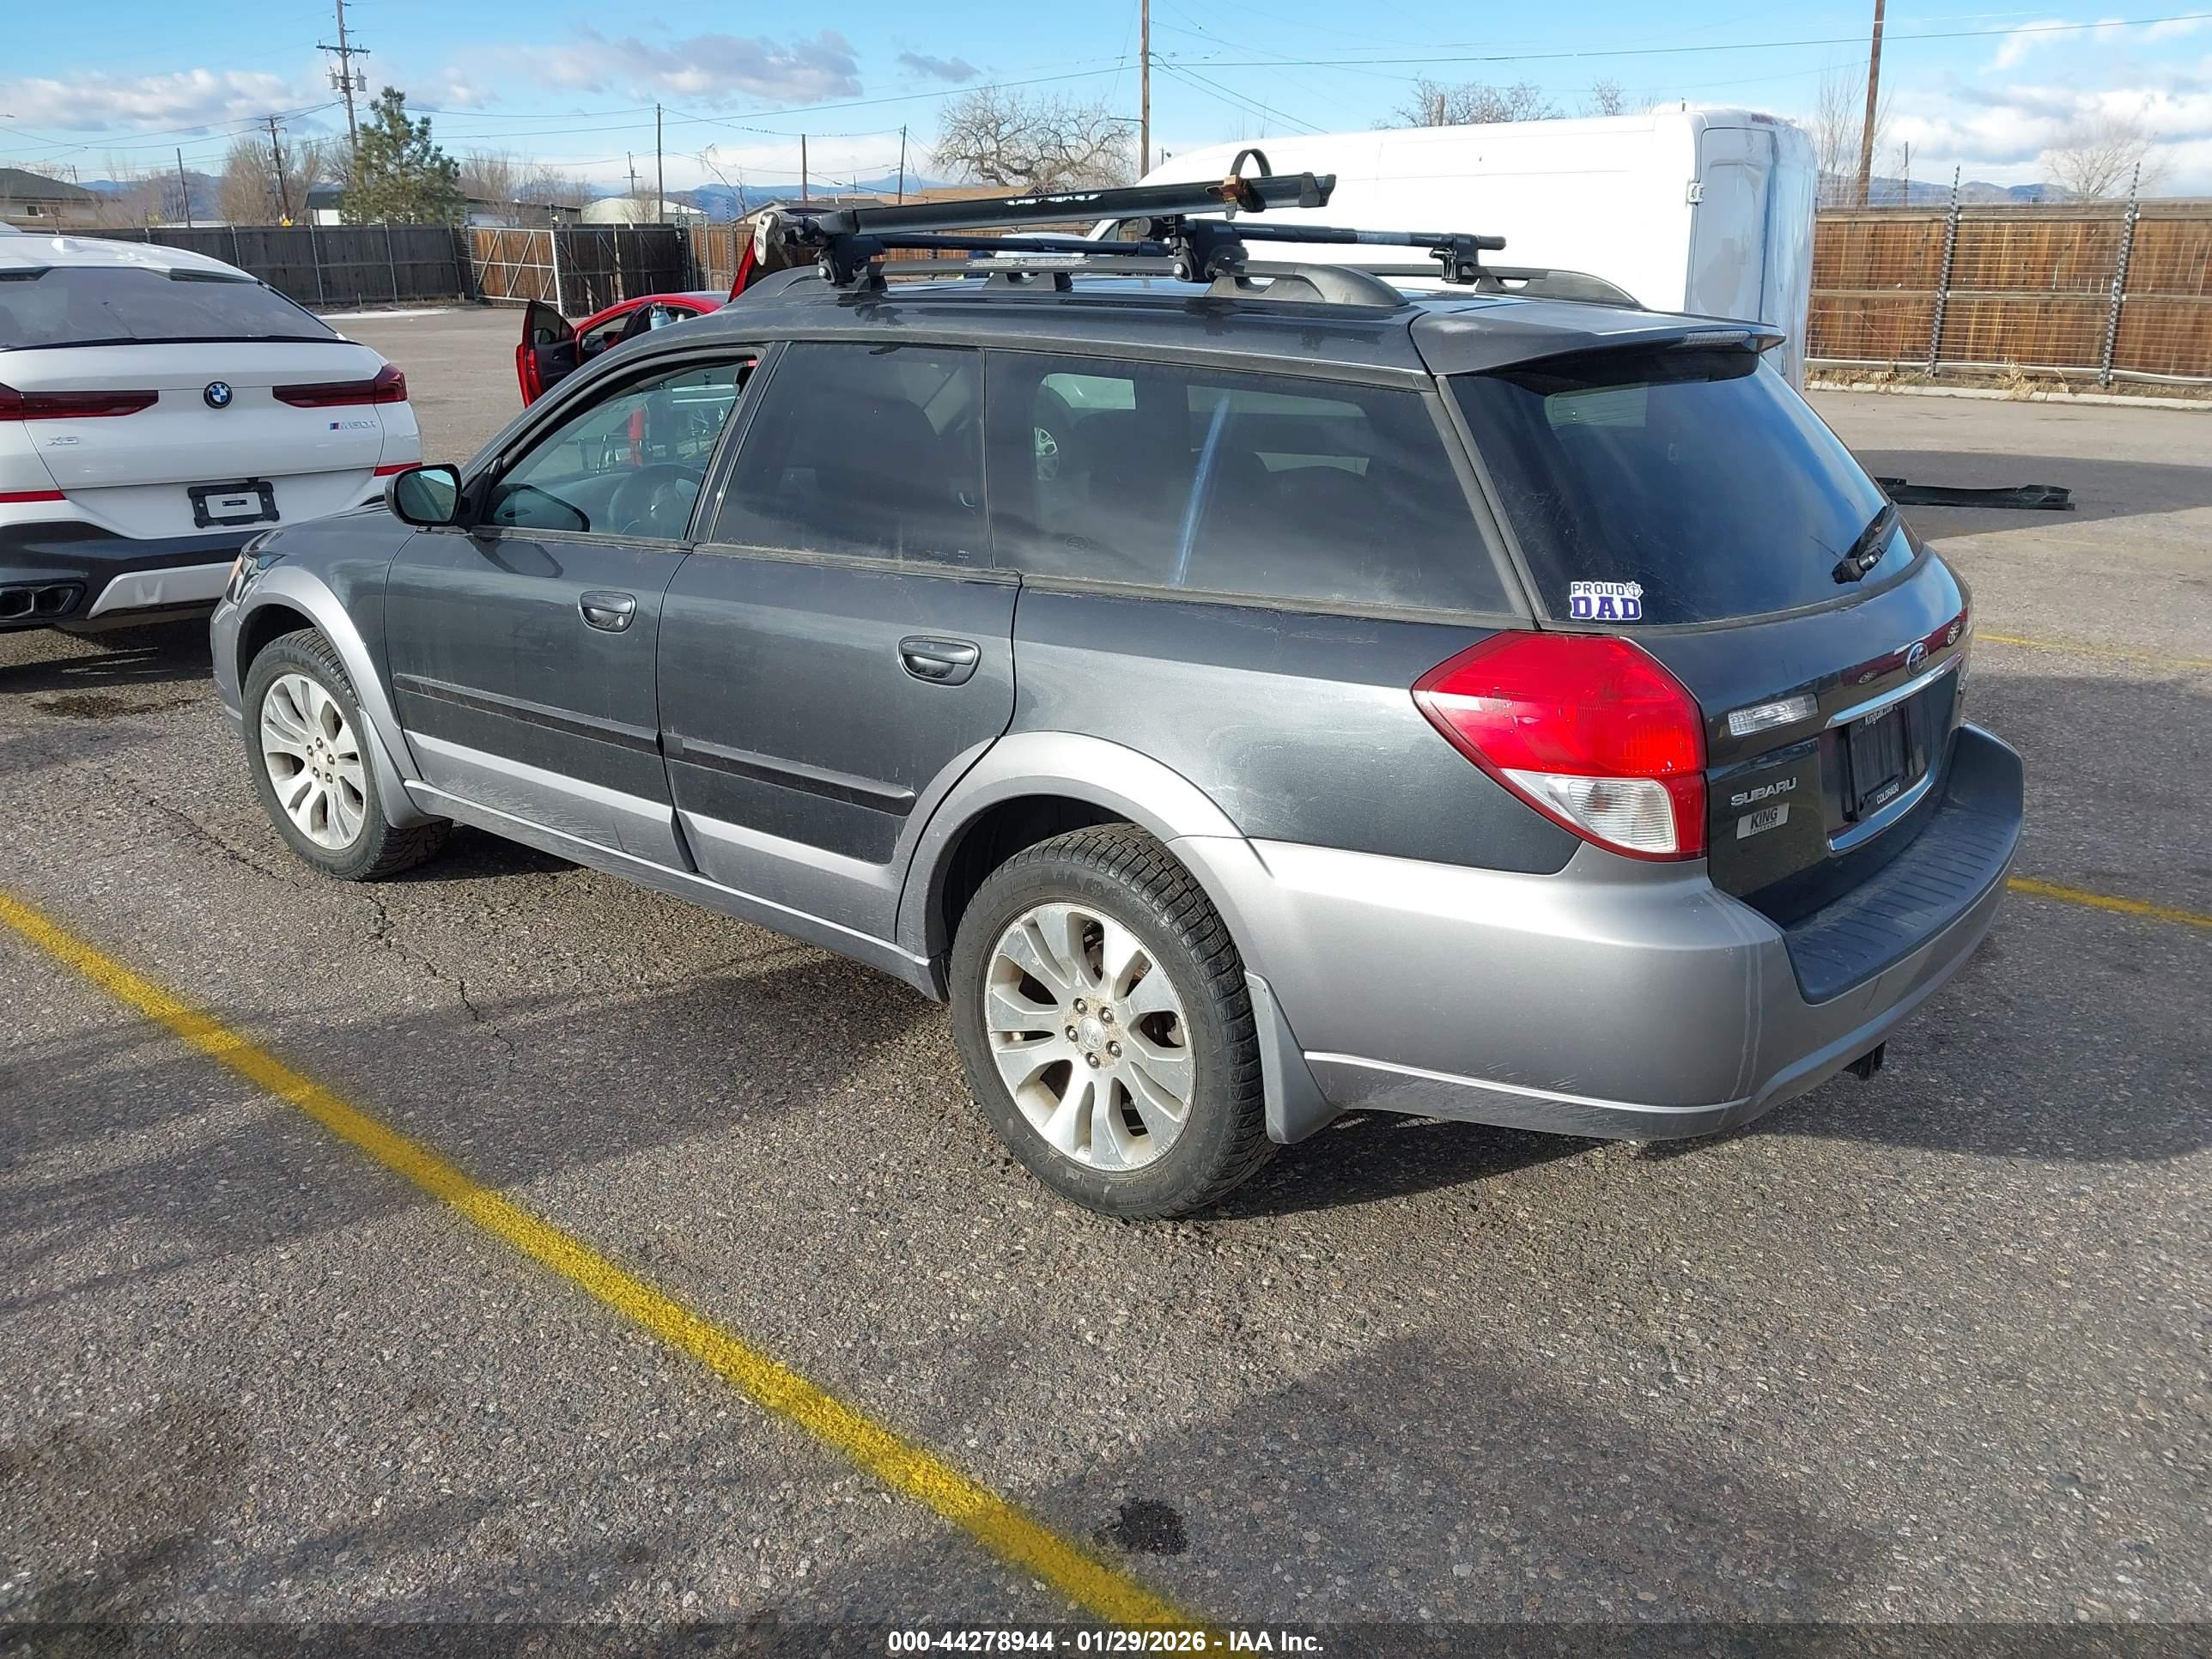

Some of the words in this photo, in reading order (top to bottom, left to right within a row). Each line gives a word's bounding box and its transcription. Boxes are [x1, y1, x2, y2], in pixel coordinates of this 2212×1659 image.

[1572, 583, 1625, 596] PROUD
[1571, 596, 1641, 619] DAD
[1730, 777, 1797, 806] SUBARU
[1875, 782, 1900, 805] COLORADO
[1751, 807, 1778, 830] KING
